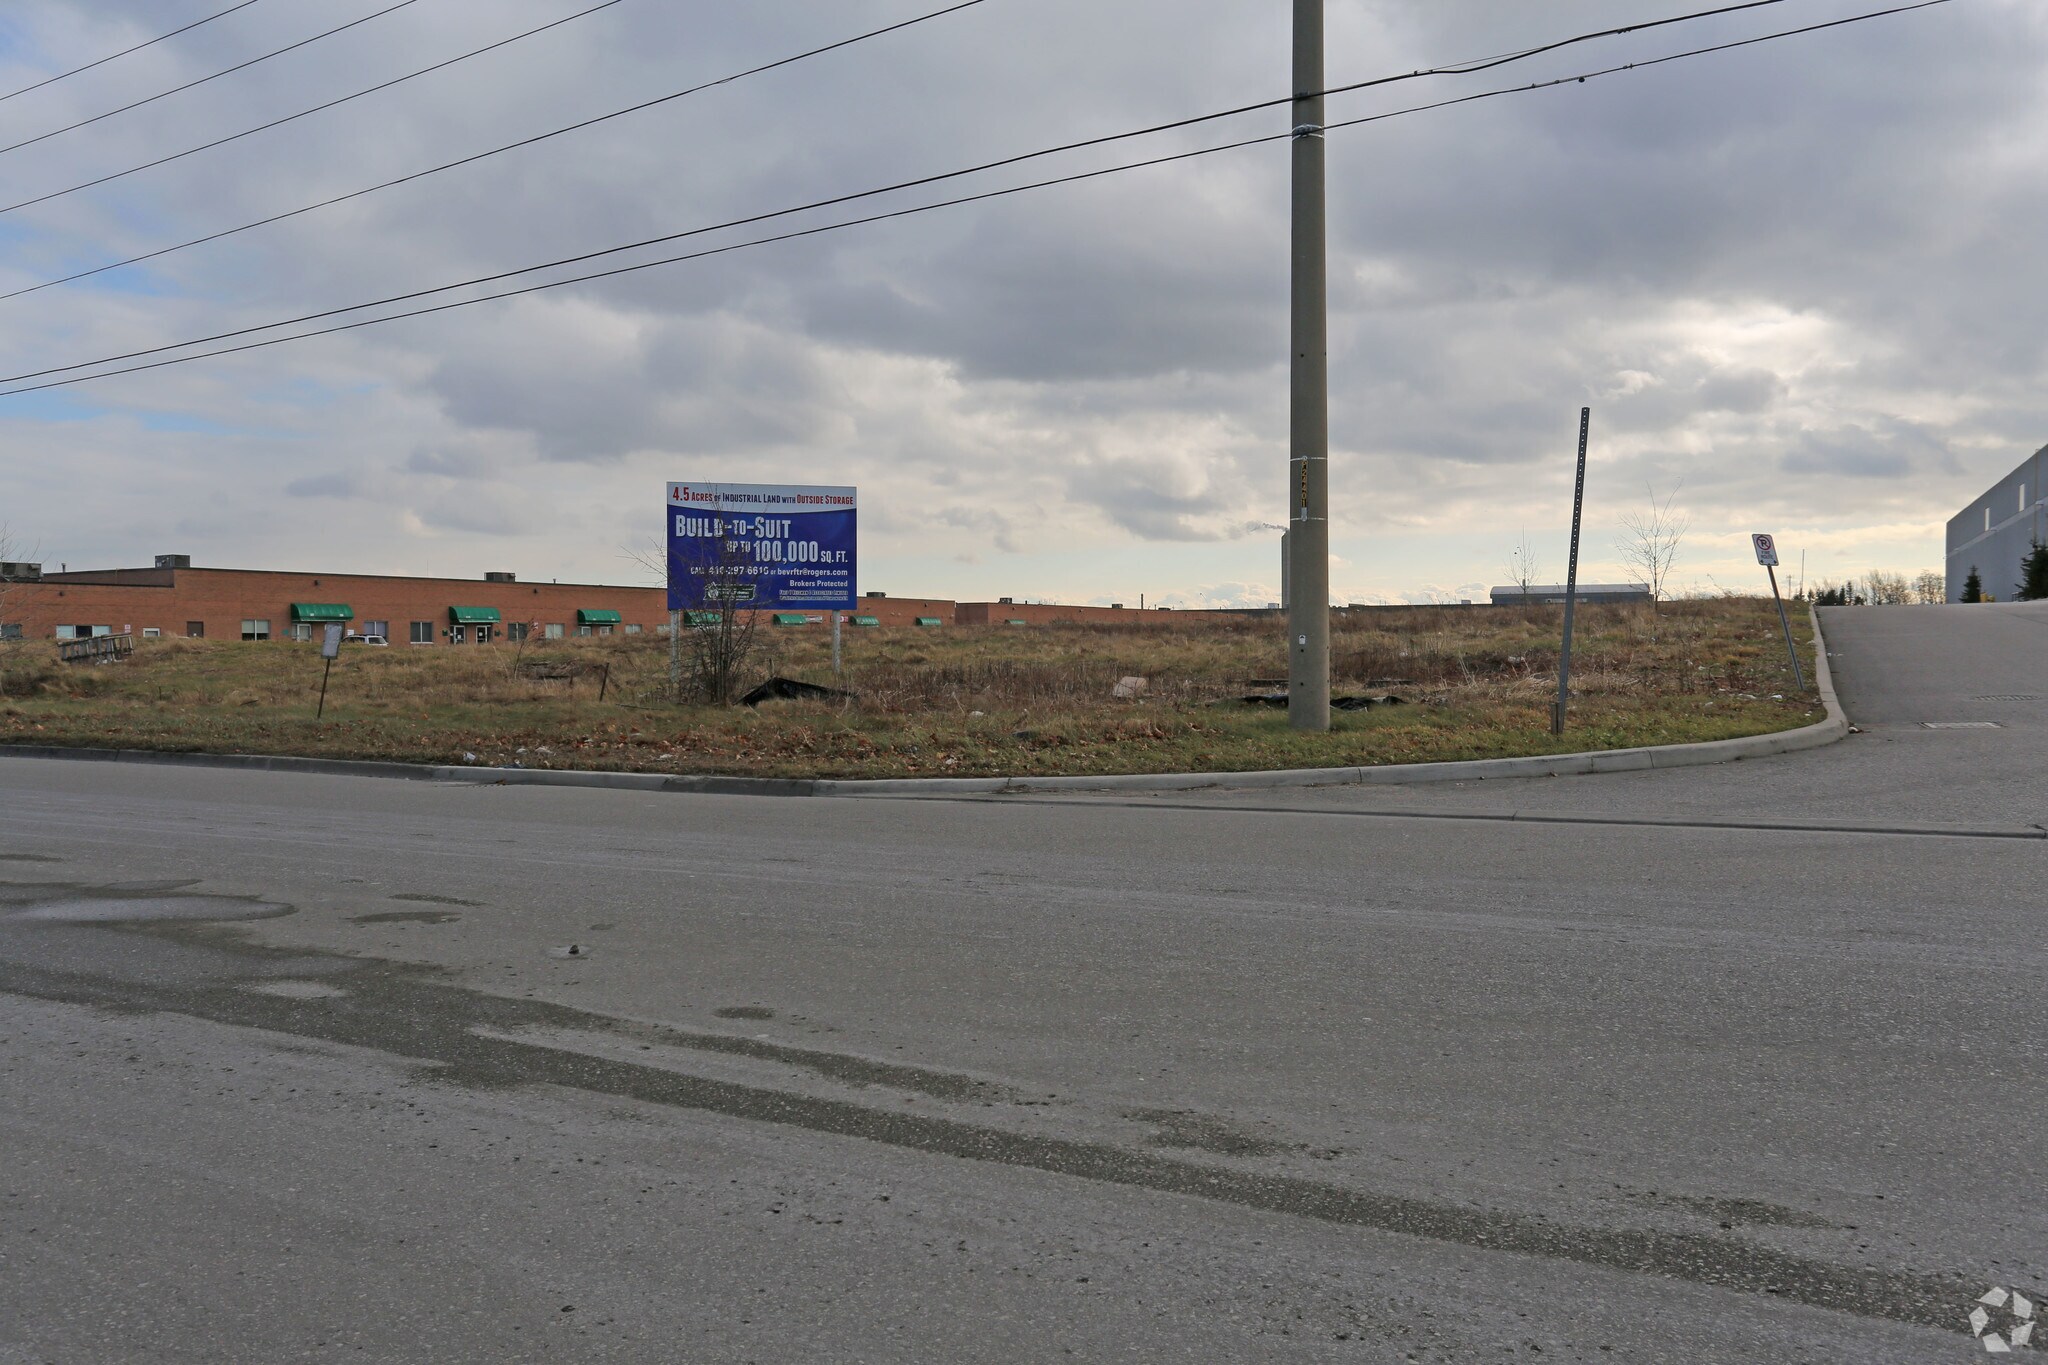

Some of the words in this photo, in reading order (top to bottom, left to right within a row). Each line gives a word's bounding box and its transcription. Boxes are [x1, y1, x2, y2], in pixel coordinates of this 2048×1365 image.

[672, 486, 690, 502] 4.5
[753, 540, 819, 564] 100,000
[820, 550, 834, 564] SQ.
[835, 551, 848, 563] FT.
[789, 579, 816, 588] Brokers
[816, 579, 848, 588] Protected
